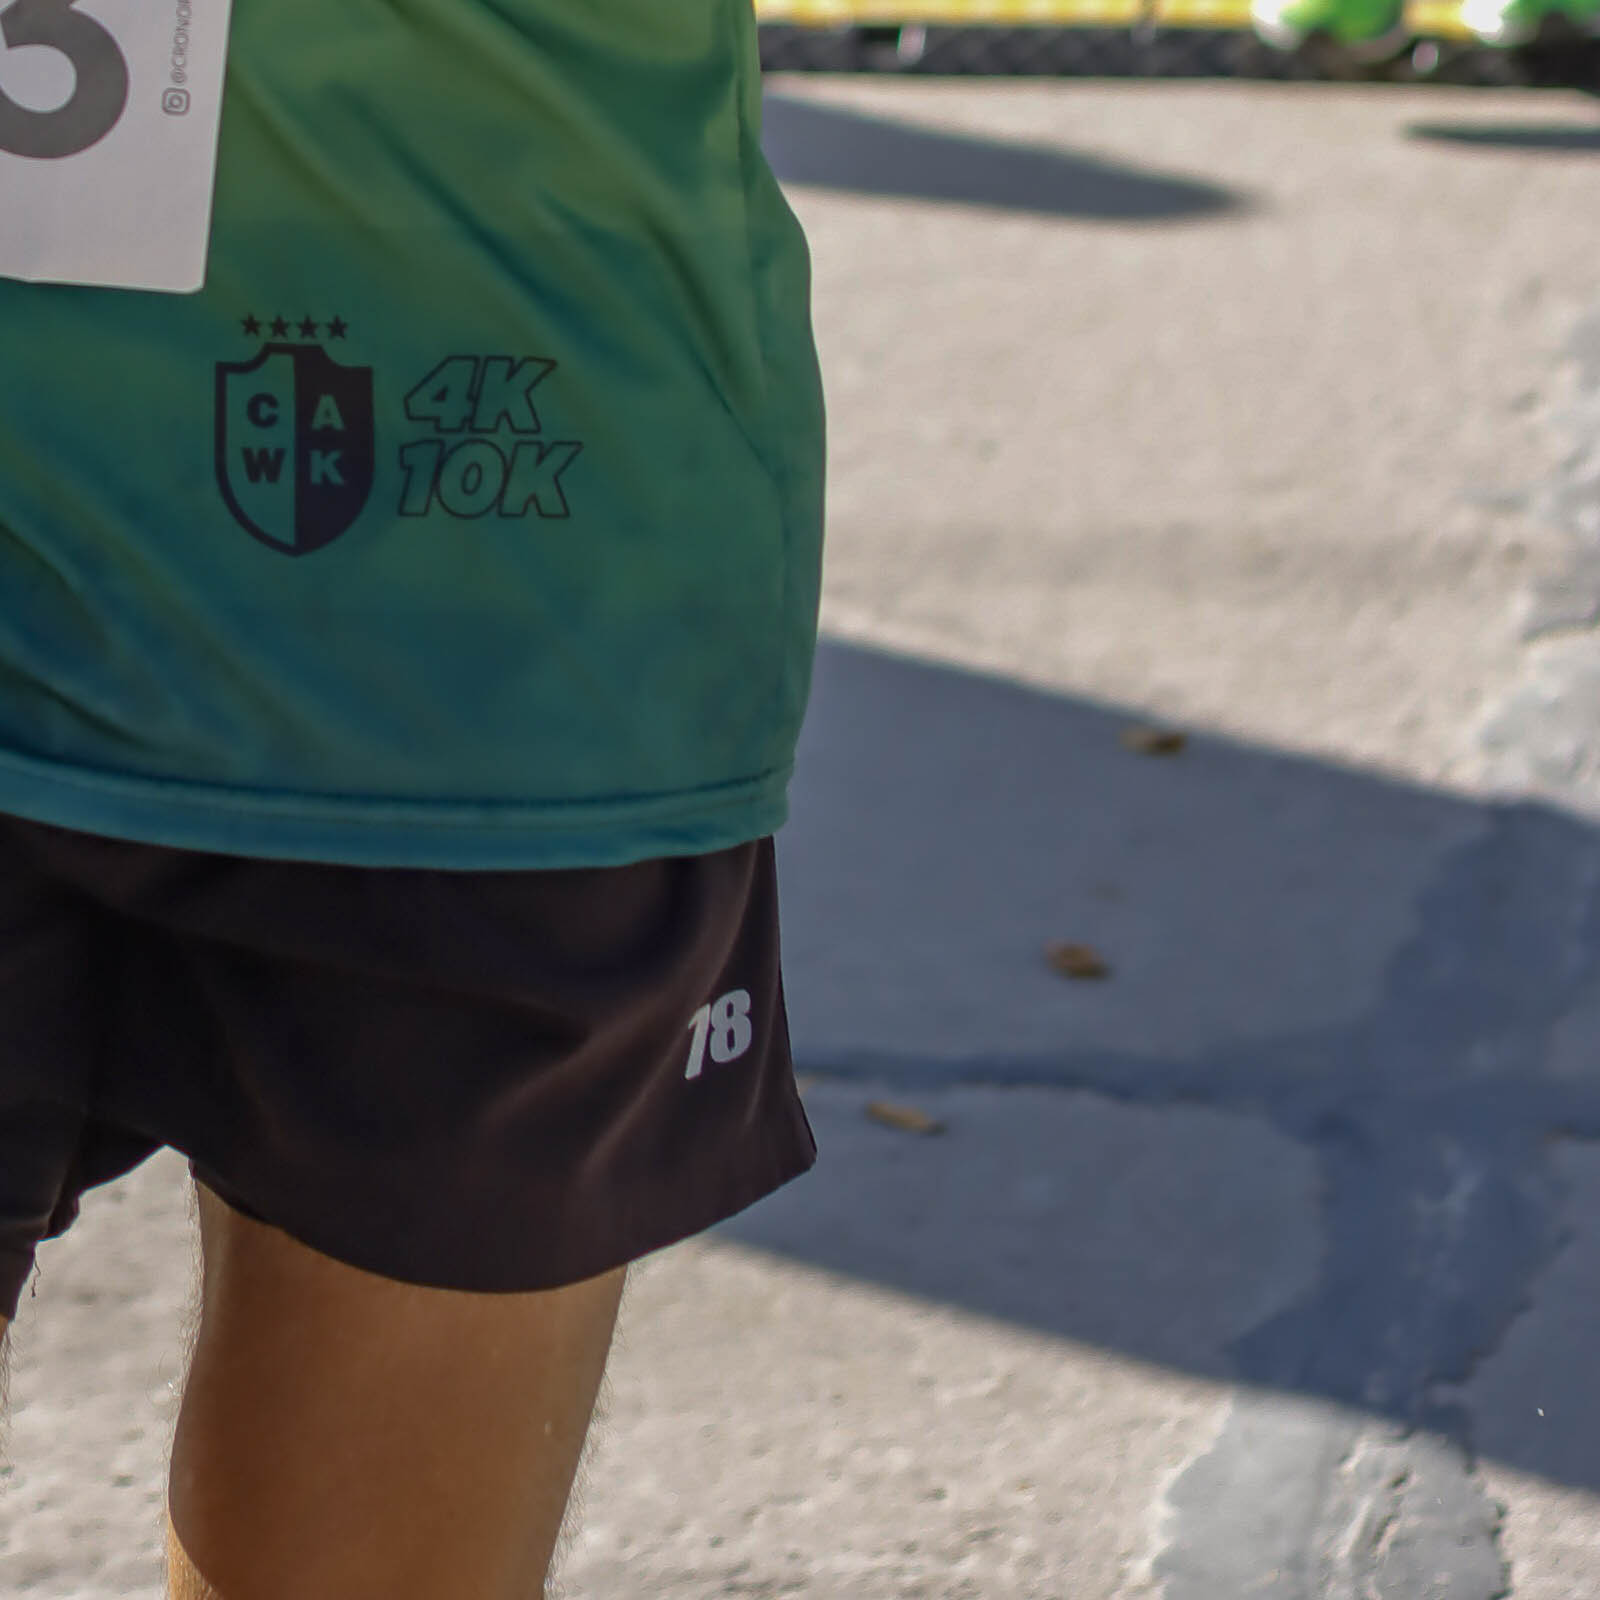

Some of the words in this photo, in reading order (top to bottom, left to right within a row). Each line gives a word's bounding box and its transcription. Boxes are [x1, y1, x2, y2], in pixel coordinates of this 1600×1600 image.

[246, 392, 280, 429] C
[311, 394, 346, 432] A
[404, 355, 559, 435] 4K
[242, 447, 287, 485] W
[309, 449, 346, 487] K
[399, 439, 583, 520] 10K
